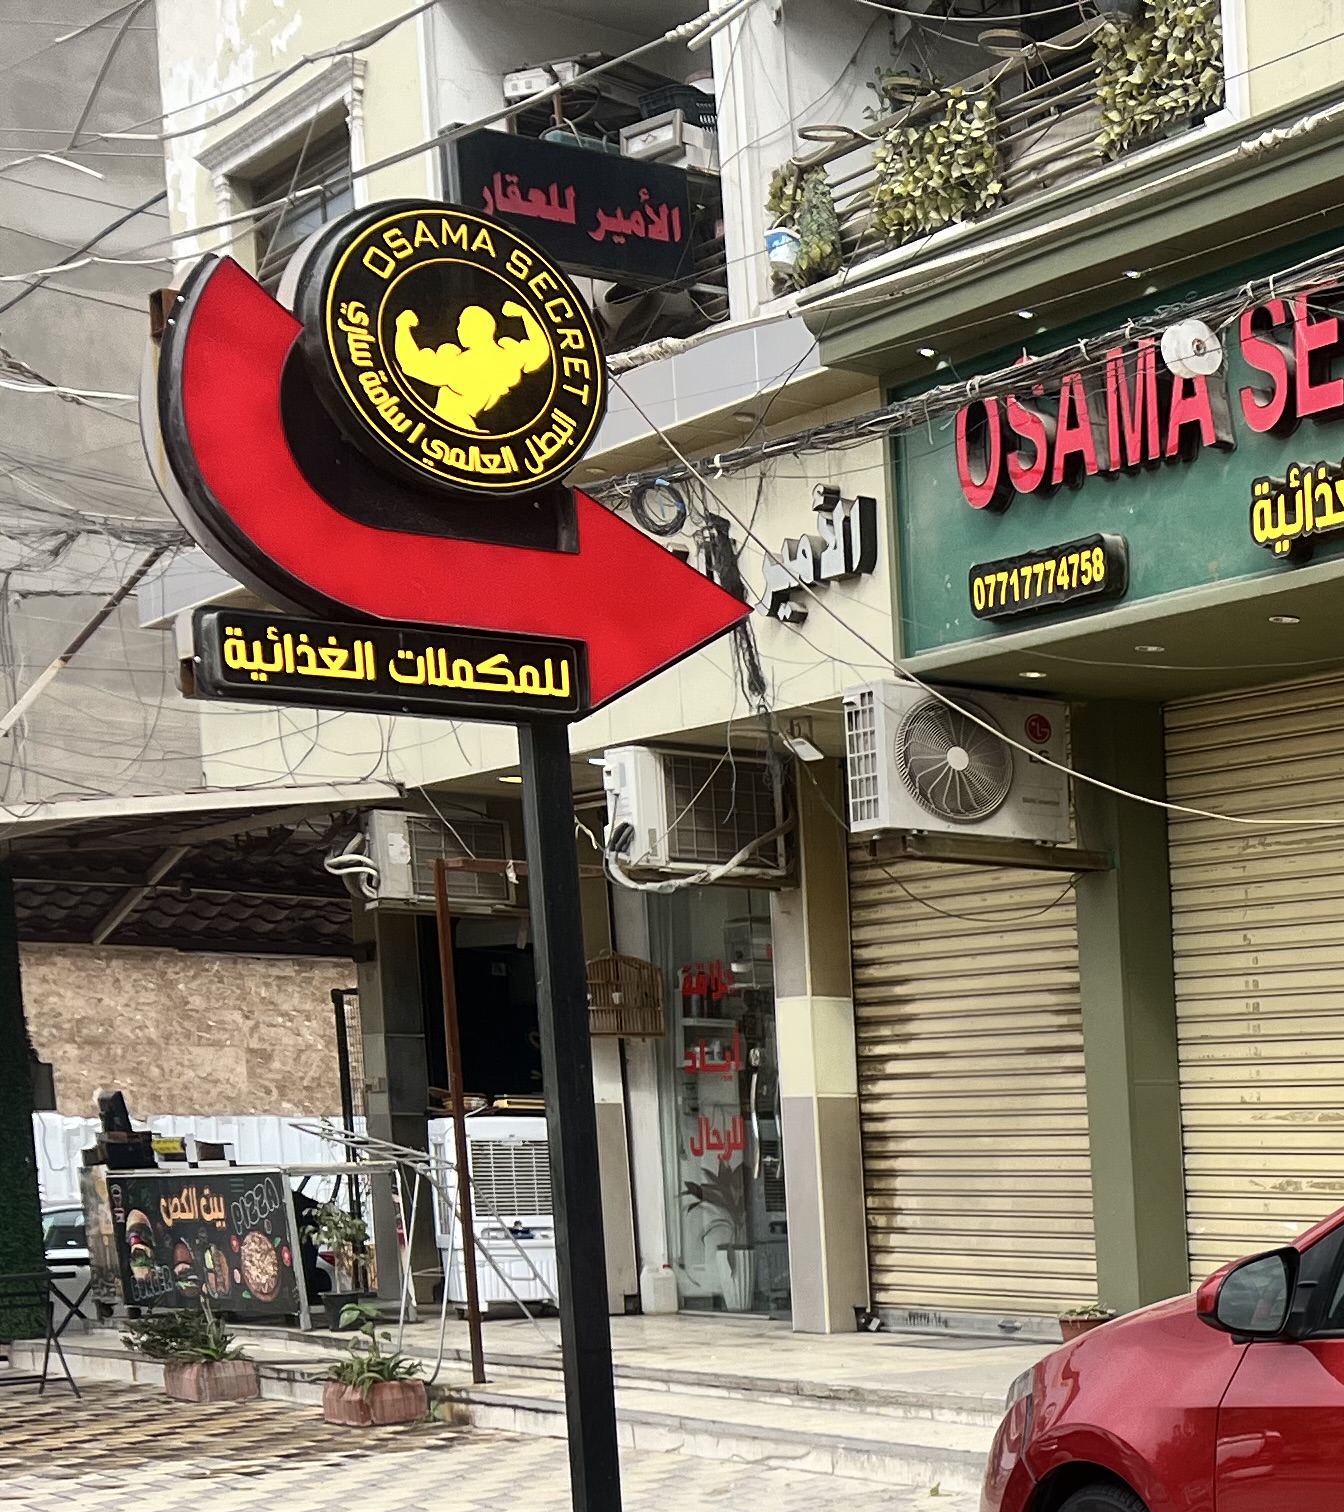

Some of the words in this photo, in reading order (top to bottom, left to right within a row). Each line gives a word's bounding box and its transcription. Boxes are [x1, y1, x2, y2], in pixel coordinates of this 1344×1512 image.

[482, 170, 577, 225] للعقار
[587, 187, 682, 245] الأمير
[362, 218, 497, 280] OSAMA
[505, 248, 592, 406] SECRET
[524, 407, 578, 475] البطل
[955, 336, 1217, 510] OSAMA
[420, 437, 519, 474] العالمي
[973, 546, 1105, 611] 07717774758
[223, 625, 376, 682] الغذائية
[389, 647, 571, 698] للمكملات
[201, 1187, 227, 1229] بيت
